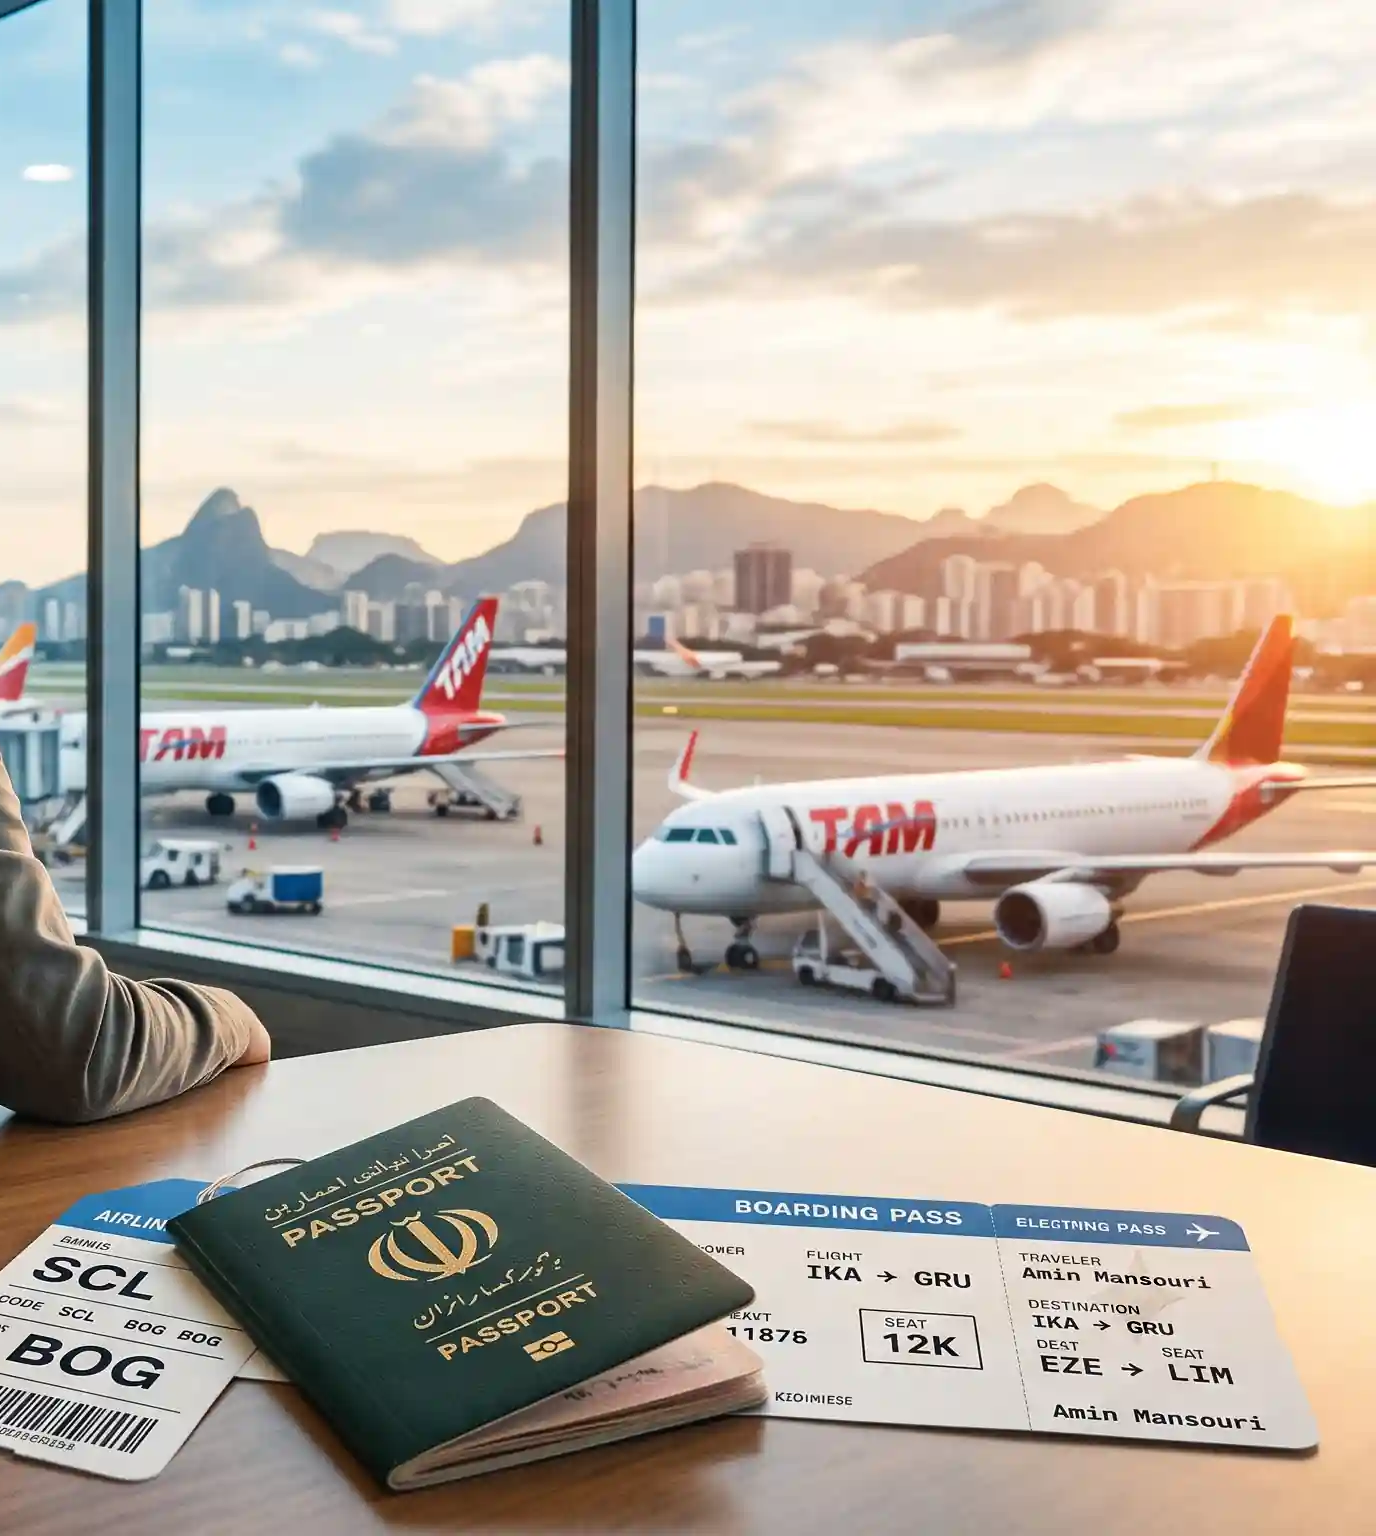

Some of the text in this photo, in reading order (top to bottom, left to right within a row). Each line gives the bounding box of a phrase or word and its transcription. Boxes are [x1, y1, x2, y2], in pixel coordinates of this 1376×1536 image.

[434, 613, 491, 700] TAM
[139, 726, 227, 762] TAM
[809, 800, 936, 858] TAM
[280, 1155, 480, 1248] PASSPORT
[734, 1199, 963, 1226] BOARDING PASS
[1117, 1223, 1167, 1235] PASS
[806, 1250, 863, 1262] FLIGHT
[1019, 1252, 1101, 1266] TRAVELER
[32, 1255, 155, 1300] SCL
[807, 1264, 971, 1289] IKA GRU
[1022, 1267, 1212, 1290] Amin Mansouri
[1028, 1299, 1141, 1315] DESTINATION
[58, 1306, 95, 1322] SCL
[123, 1319, 167, 1336] BOG
[177, 1330, 223, 1347] BOG
[436, 1281, 598, 1361] PASSPORT
[884, 1317, 928, 1330] SEAT
[1032, 1315, 1175, 1336] IKA GRU
[882, 1333, 961, 1357] 12K
[1161, 1346, 1205, 1360] SEAT
[5, 1332, 167, 1391] BOG
[1040, 1355, 1234, 1386] EZE LIM
[1053, 1403, 1266, 1432] Amin Mansouri
